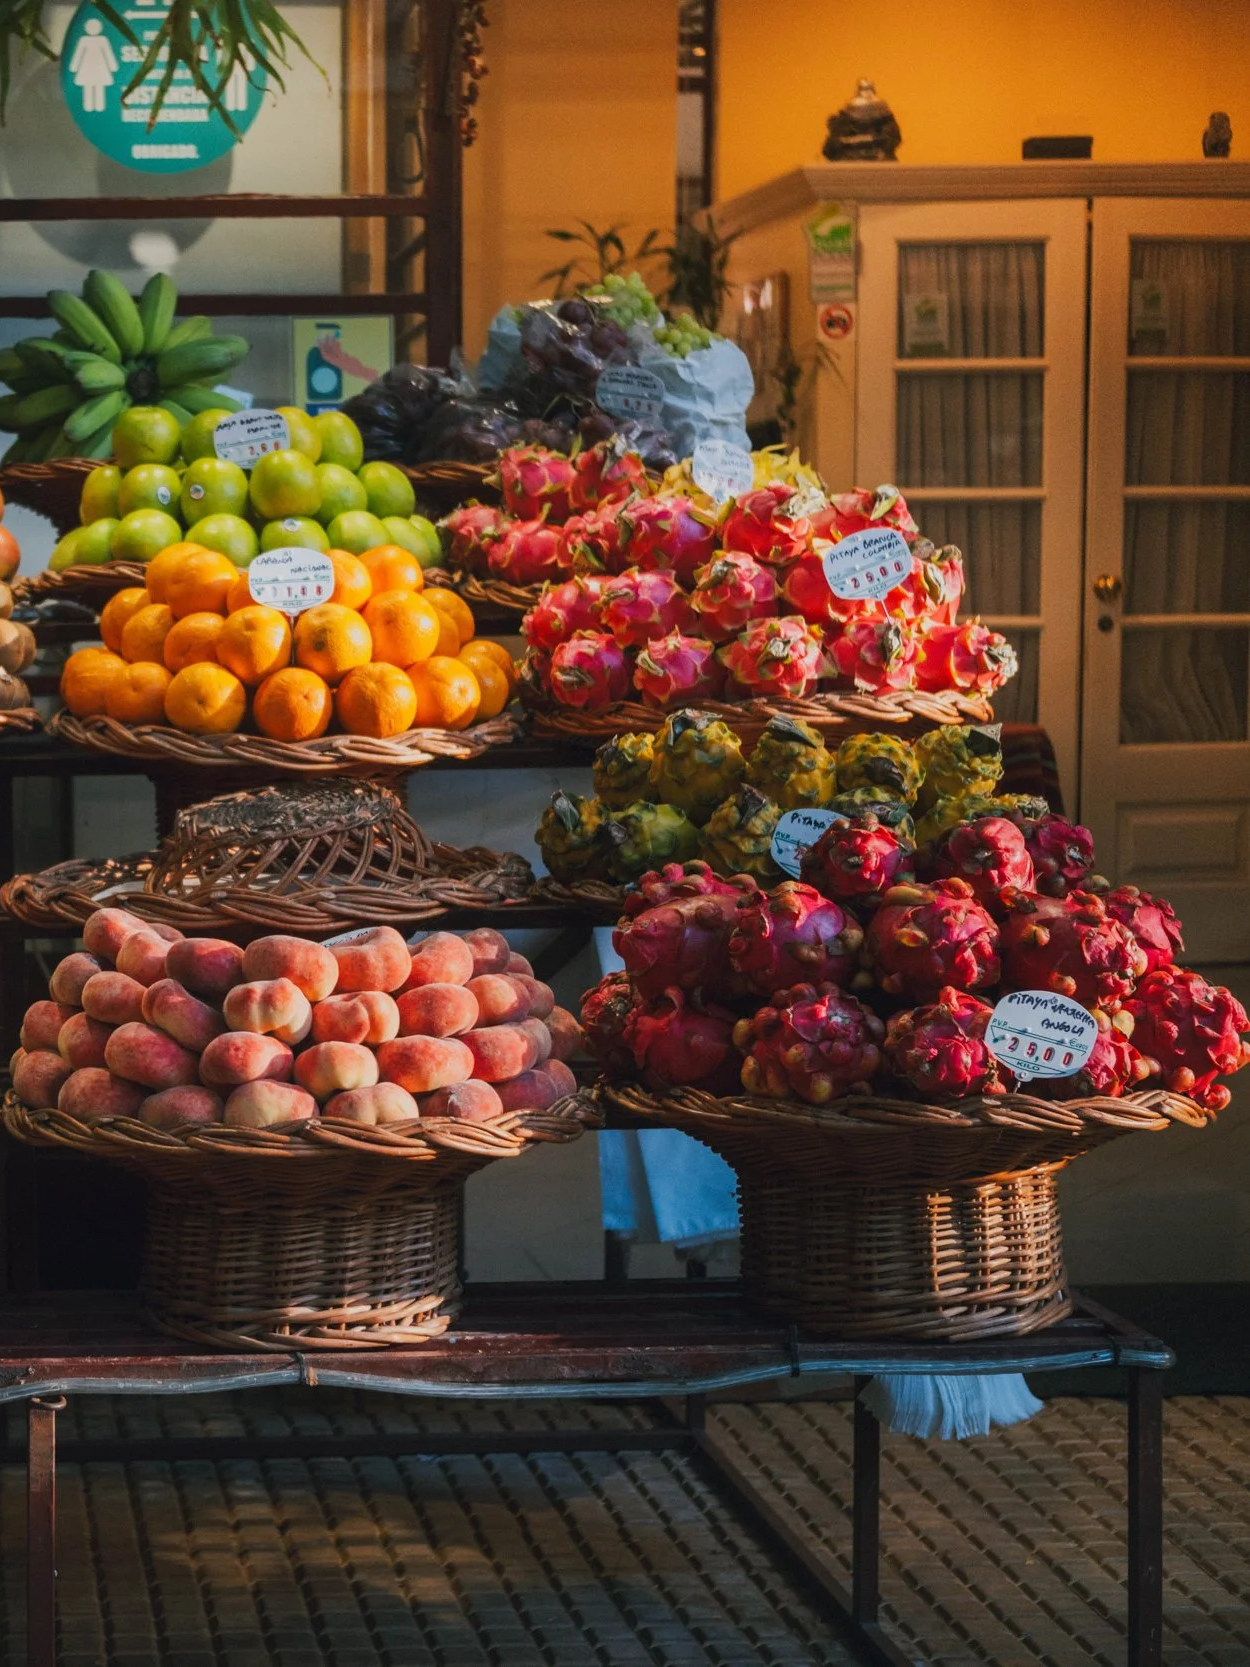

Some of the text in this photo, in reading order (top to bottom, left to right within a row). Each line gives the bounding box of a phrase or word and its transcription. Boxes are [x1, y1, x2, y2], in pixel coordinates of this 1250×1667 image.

[1041, 1018, 1085, 1036] ANGOLA
[1007, 1036, 1074, 1066] 25,00
[1016, 1061, 1040, 1071] KILO
